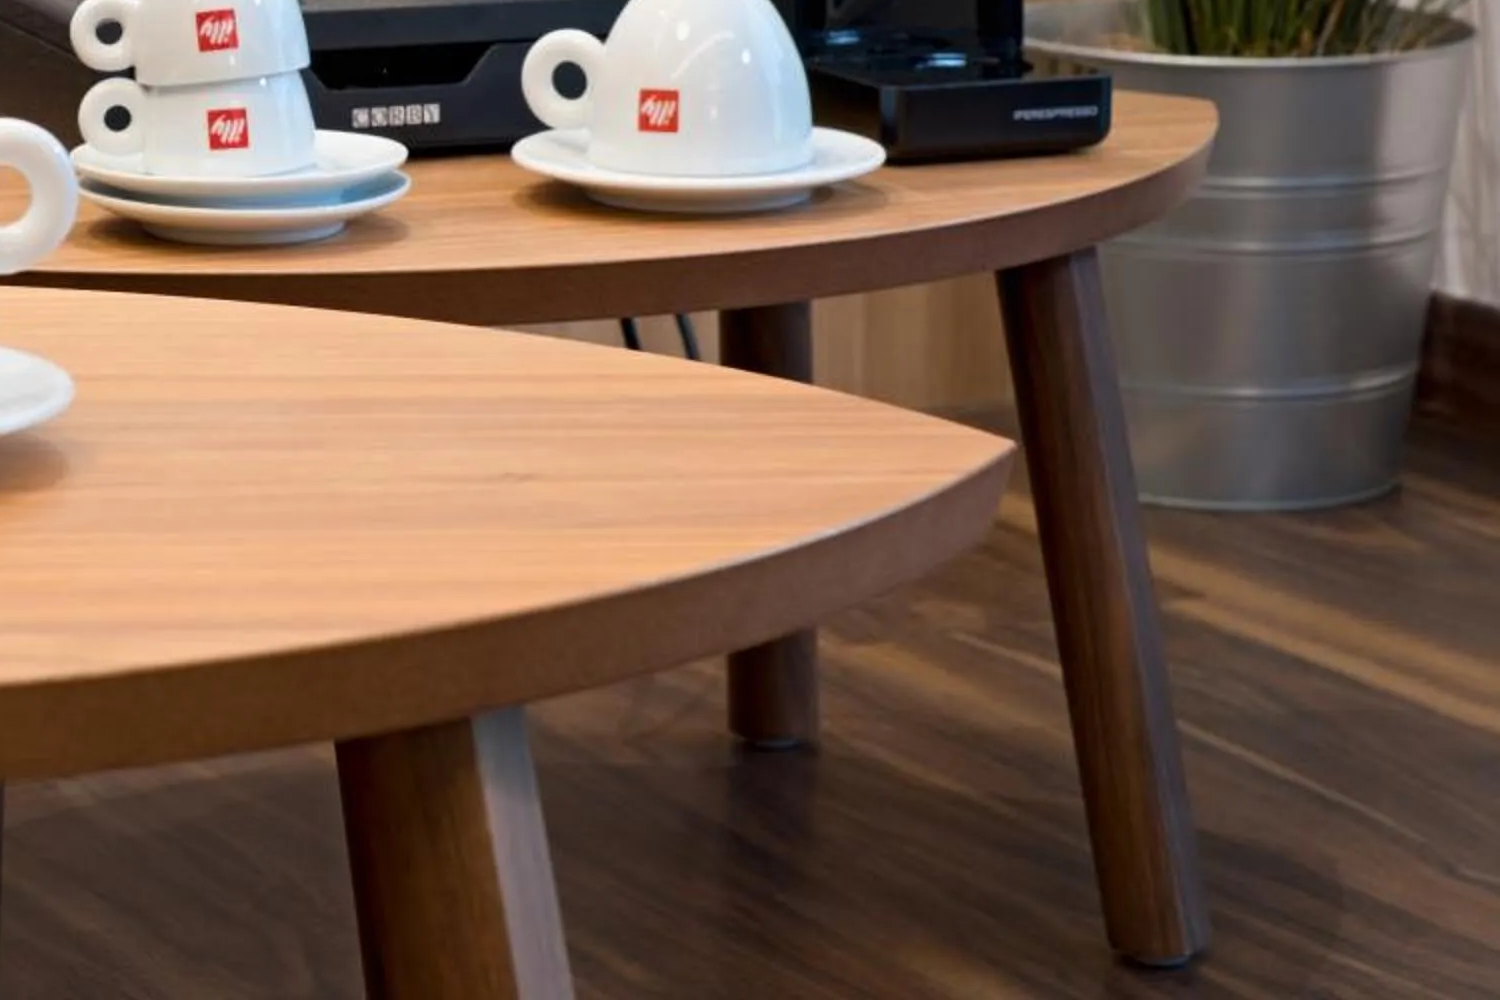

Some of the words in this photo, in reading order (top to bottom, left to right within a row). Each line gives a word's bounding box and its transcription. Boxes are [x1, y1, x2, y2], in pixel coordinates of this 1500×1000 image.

[200, 15, 235, 45] illy
[352, 104, 440, 128] CORBY
[641, 93, 677, 128] illy
[211, 113, 246, 146] illy
